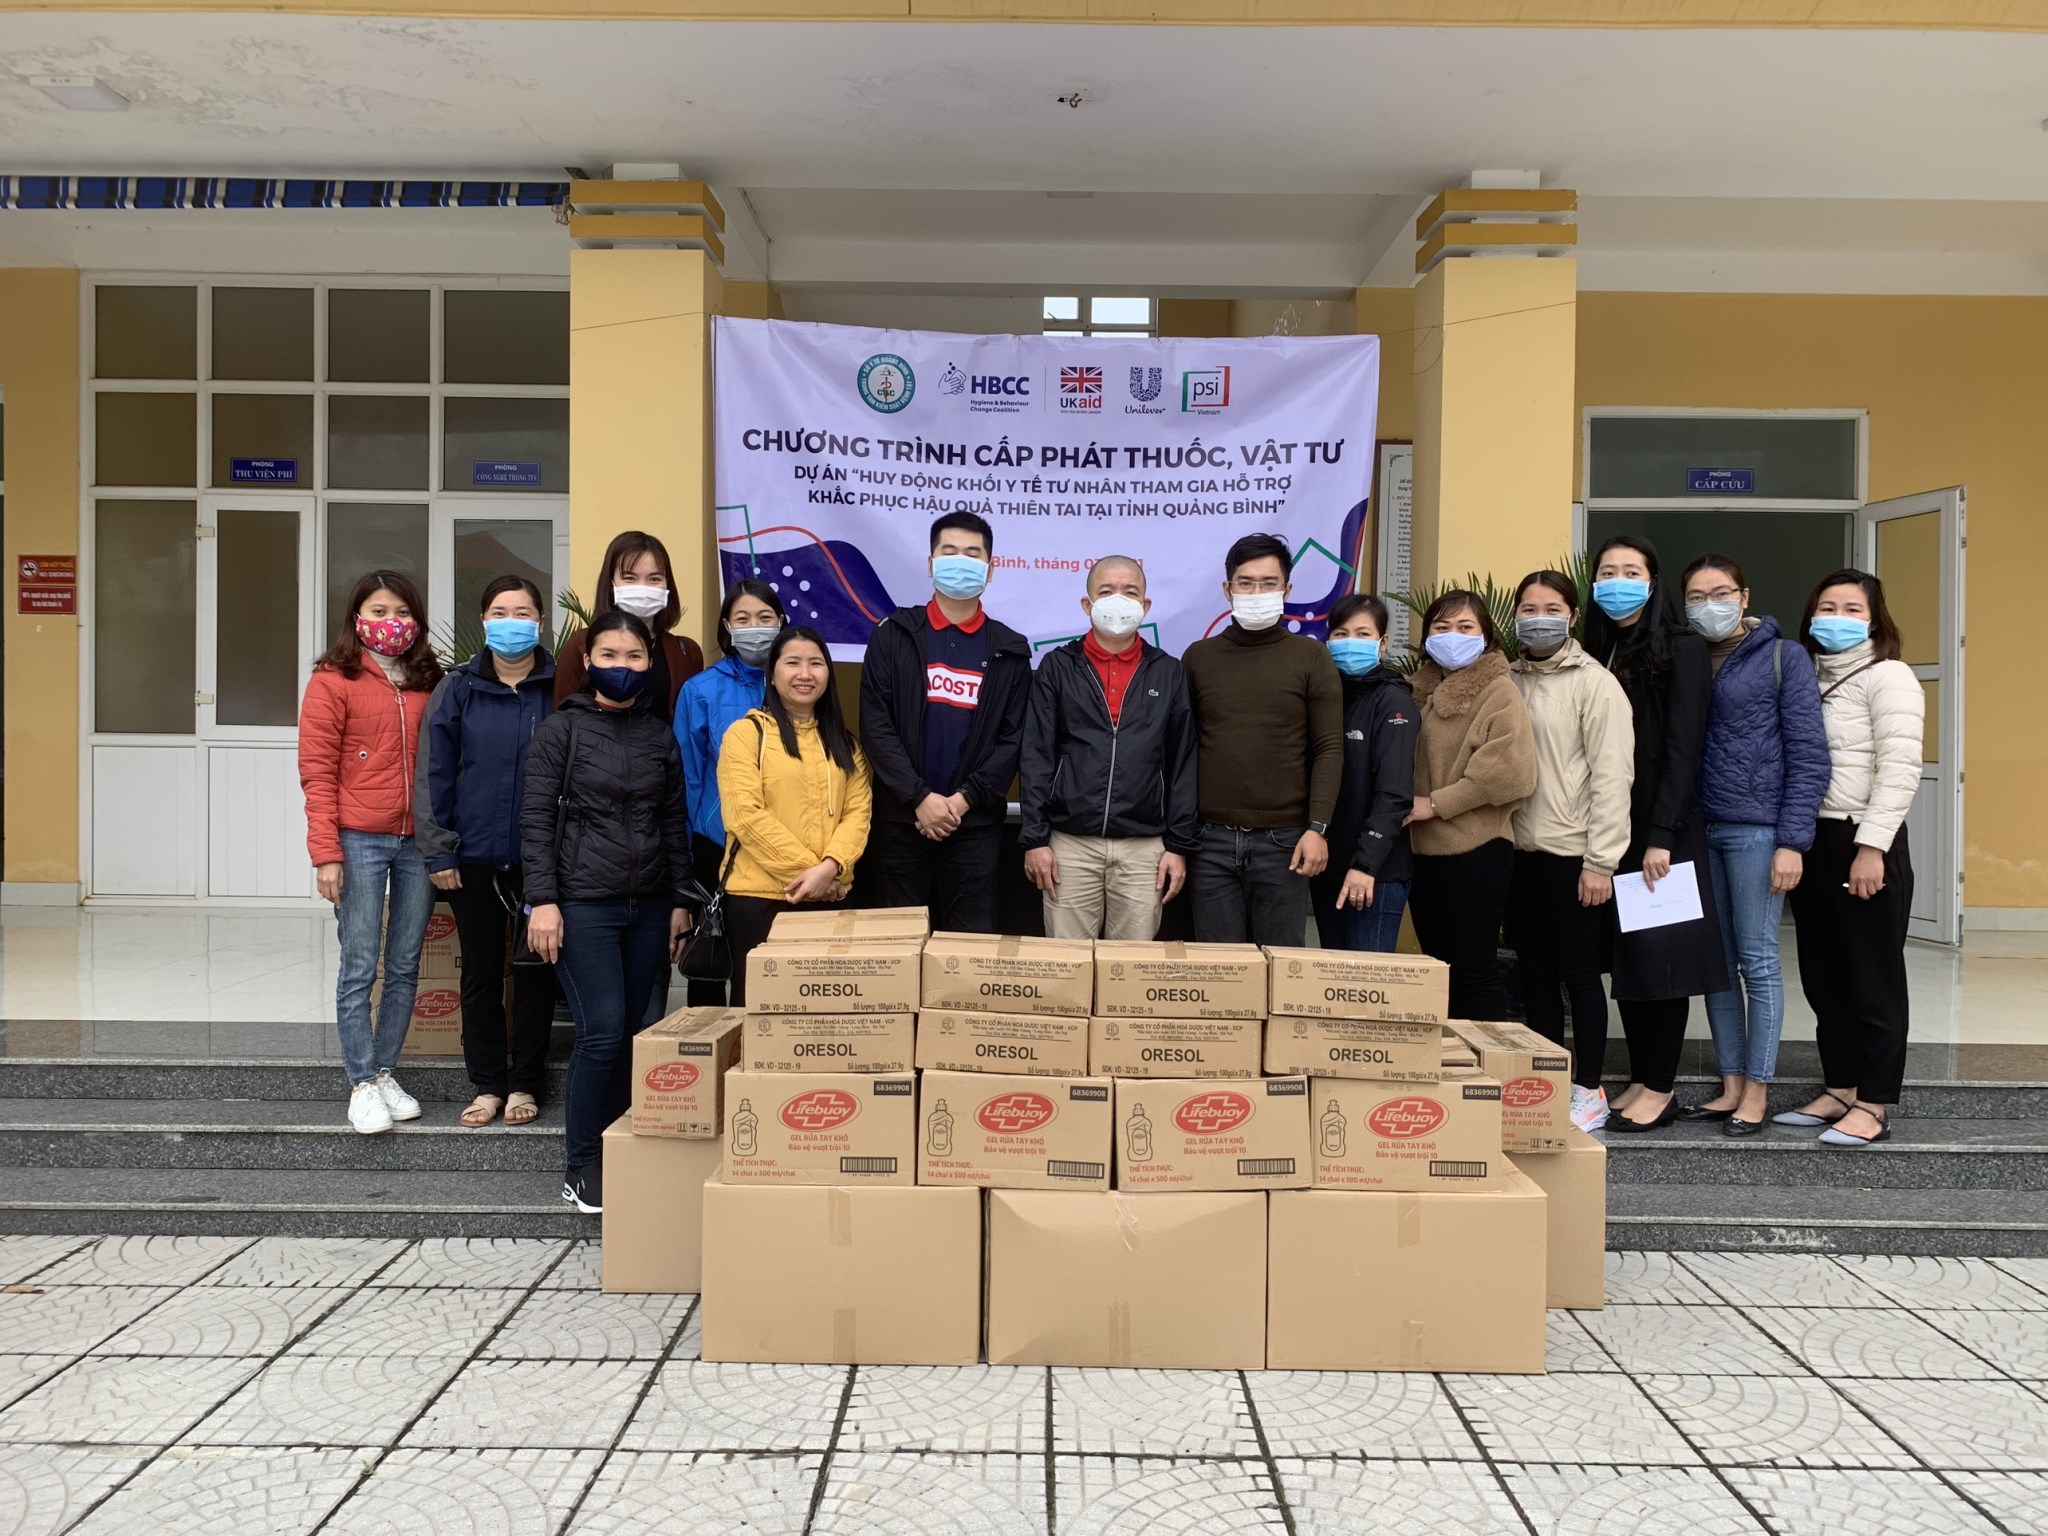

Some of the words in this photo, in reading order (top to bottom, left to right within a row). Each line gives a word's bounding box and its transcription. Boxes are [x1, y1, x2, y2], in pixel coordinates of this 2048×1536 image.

[971, 375, 1030, 396] HBCC
[1193, 377, 1219, 401] psi
[970, 399, 994, 408] Hygiene
[970, 406, 992, 414] Change
[1125, 405, 1166, 415] Unilever
[742, 428, 870, 458] CHƯƠNG
[877, 436, 967, 466] TRÌNH
[974, 435, 1034, 467] CẤP
[1041, 441, 1117, 469] PHÁT
[1124, 437, 1233, 470] THUỐC,
[1240, 438, 1297, 472] VẬT
[1304, 438, 1344, 464] TƯ
[235, 469, 253, 478] THU
[255, 468, 276, 480] VIỆN
[277, 468, 293, 478] PHÍ
[794, 464, 819, 484] DỰ
[822, 463, 847, 481] ÁN
[900, 472, 953, 492] ĐỘNG
[957, 473, 1001, 492] KHỐI
[1005, 479, 1017, 493] Y
[1021, 474, 1042, 493] TẾ
[1046, 478, 1070, 493] TƯ
[1074, 476, 1126, 494] NHÂN
[1130, 480, 1183, 494] THAM
[1187, 478, 1219, 493] GIA
[1223, 472, 1250, 492] HỖ
[1254, 474, 1292, 494] TRỢ
[1695, 477, 1718, 489] CẤP
[1721, 478, 1745, 489] CỨU
[808, 488, 855, 505] KHẮC
[859, 493, 908, 512] PHỤC
[913, 495, 950, 515] HẬU
[955, 497, 993, 514] QUẢ
[997, 498, 1050, 516] THIÊN
[1055, 502, 1081, 516] TAI
[1086, 502, 1112, 520] TẠI
[1116, 498, 1158, 517] TỈNH
[1162, 498, 1228, 517] QUẢNG
[991, 555, 1030, 570] Bình,
[1034, 557, 1080, 572] tháng
[799, 983, 863, 997] ORESOL
[980, 983, 1043, 999] ORESOL
[1146, 988, 1210, 1003] ORESOL
[1324, 987, 1390, 1005] ORESOL
[415, 999, 459, 1009] Lifebuoy
[1307, 1005, 1321, 1014] 32125
[1325, 1007, 1331, 1015] 19
[680, 1045, 711, 1053] 68369908
[794, 1043, 857, 1057] ORESOL
[975, 1043, 1038, 1060] ORESOL
[1141, 1048, 1205, 1062] ORESOL
[1329, 1047, 1393, 1064] ORESOL
[1534, 1060, 1566, 1068] 68369908
[649, 1071, 696, 1082] Lifebuoy
[876, 1084, 910, 1092] 68369908
[1072, 1088, 1106, 1098] 68369908
[1269, 1083, 1303, 1092] 68369908
[1465, 1088, 1499, 1097] 68369908
[1502, 1086, 1550, 1098] Lifebuoy
[788, 1103, 852, 1118] Lifebuoy
[984, 1105, 1049, 1120] Lifebuoy
[1181, 1105, 1246, 1120] Lifebuoy
[1375, 1110, 1440, 1125] Lifebuoy
[790, 1134, 802, 1142] GEL
[804, 1131, 818, 1142] RỬA
[819, 1134, 833, 1142] TAY
[834, 1133, 848, 1142] KHÔ
[986, 1136, 999, 1144] GEL
[1000, 1135, 1014, 1144] RỬA
[1015, 1137, 1029, 1145] TAY
[1030, 1137, 1044, 1145] KHÔ
[1185, 1137, 1198, 1145] GEL
[1199, 1135, 1214, 1145] RỬA
[1214, 1137, 1228, 1145] TAY
[1229, 1136, 1244, 1144] KHÔ
[788, 1143, 802, 1151] Bảo
[802, 1144, 811, 1153] vệ
[812, 1144, 829, 1152] vượt
[829, 1144, 842, 1152] trội
[984, 1145, 997, 1153] Bảo
[998, 1146, 1007, 1155] vệ
[1008, 1147, 1024, 1155] vượt
[1025, 1147, 1038, 1156] trội
[1391, 1140, 1406, 1149] RỬA
[1421, 1141, 1436, 1149] KHÔ
[1390, 1151, 1399, 1159] vệ
[1400, 1152, 1416, 1160] vượt
[1416, 1151, 1430, 1159] trội
[740, 1169, 753, 1177] chai
[771, 1170, 796, 1178] ml/chai
